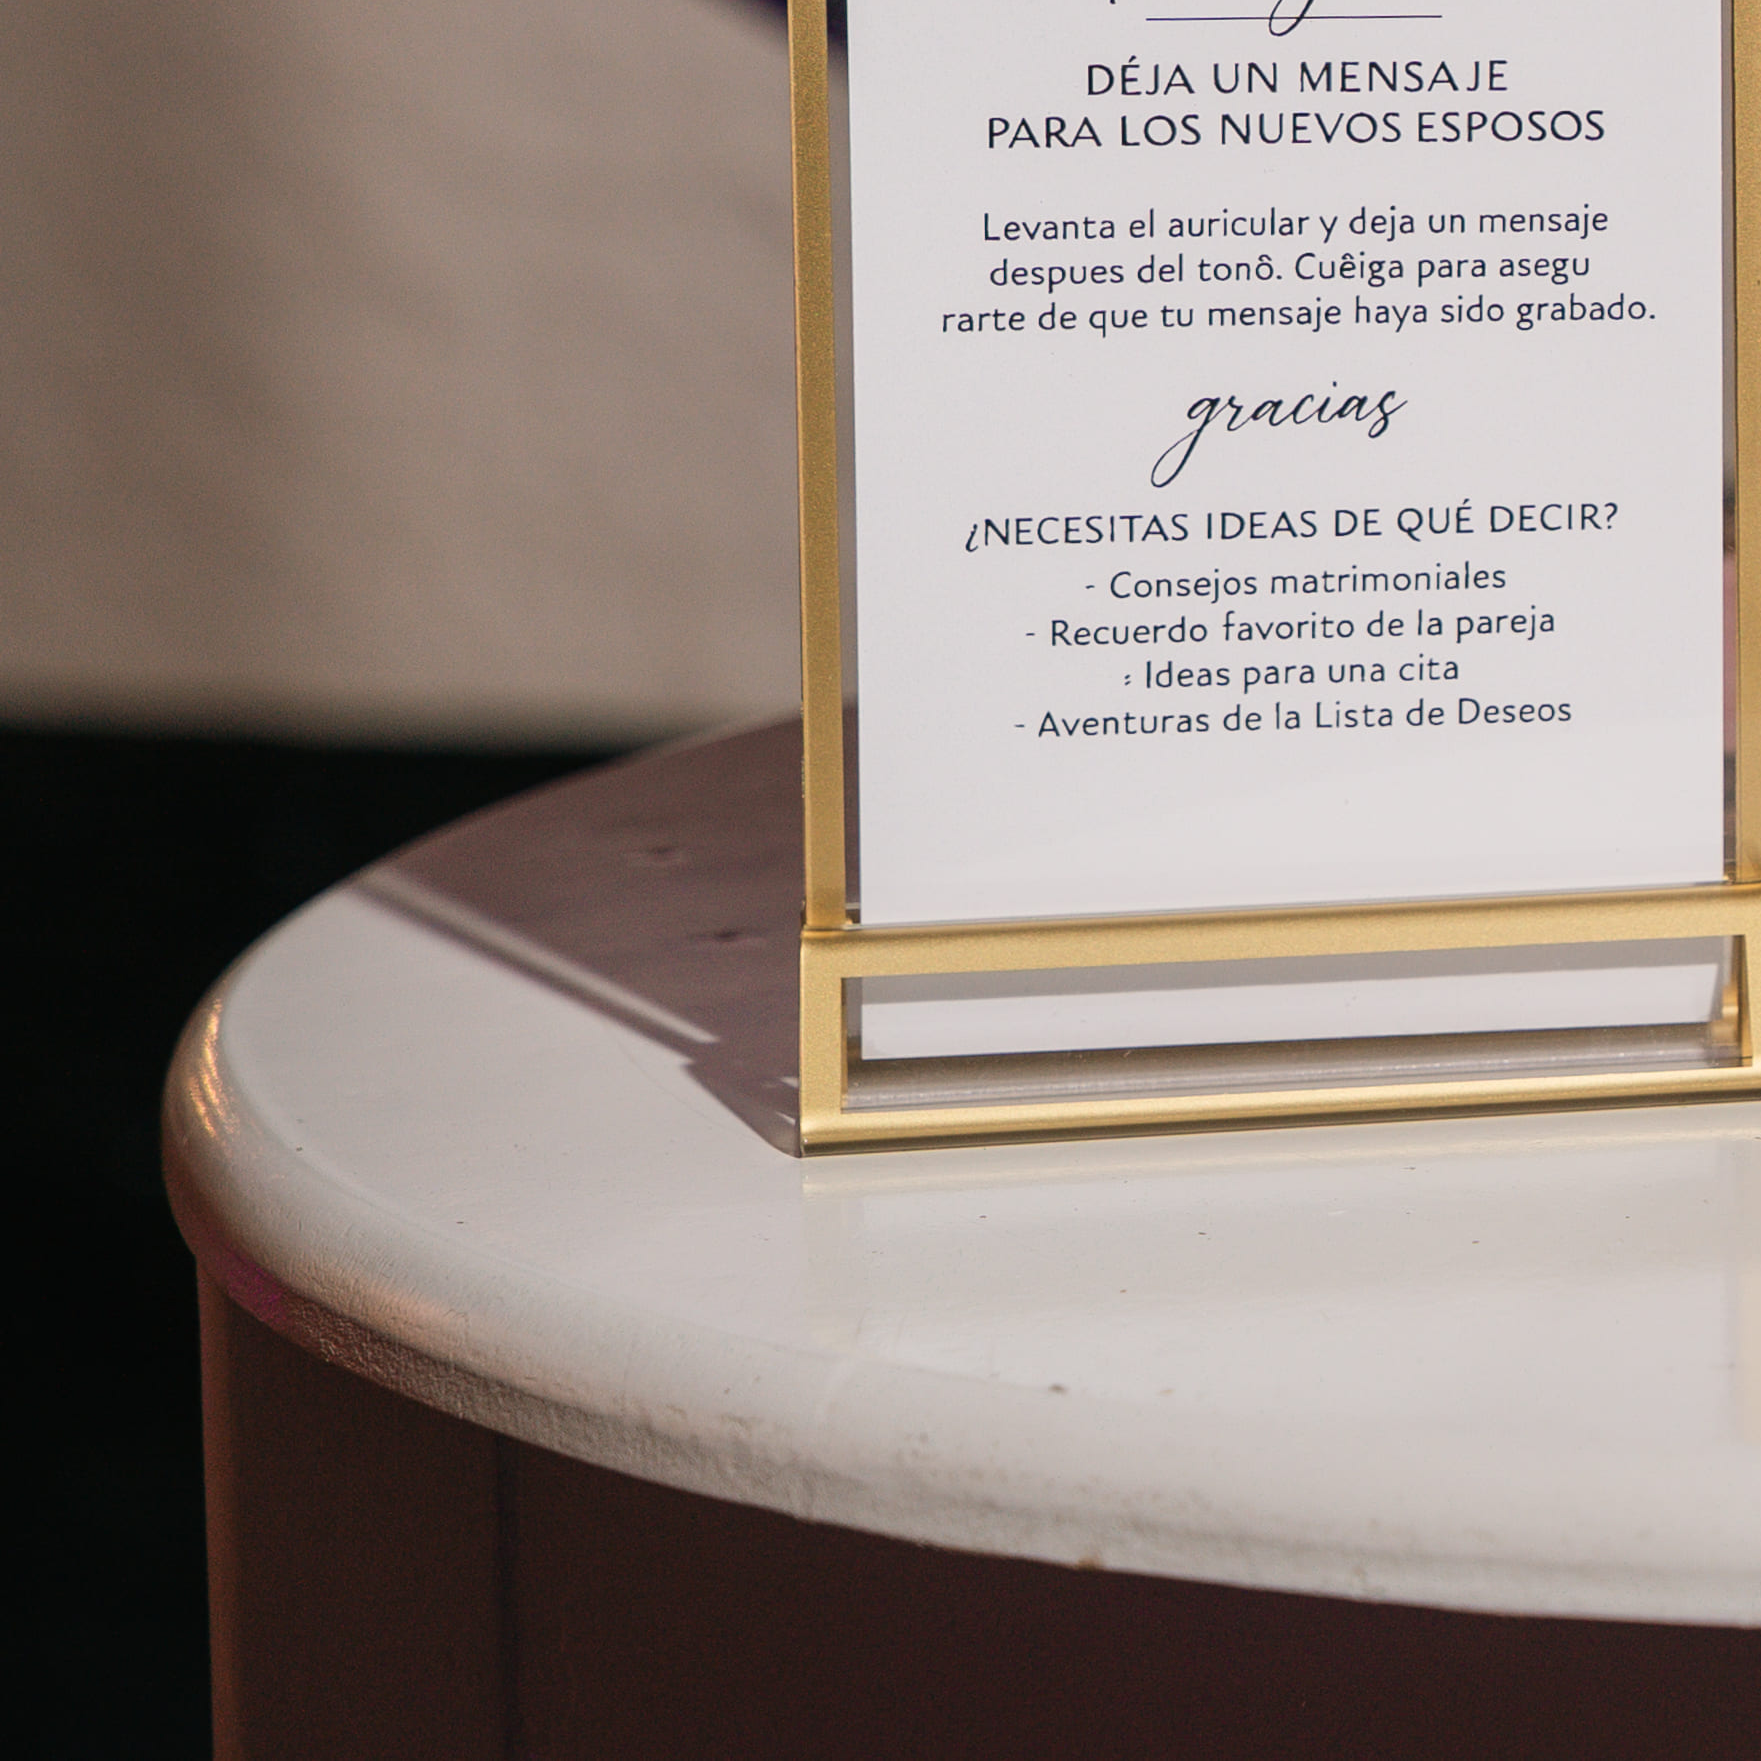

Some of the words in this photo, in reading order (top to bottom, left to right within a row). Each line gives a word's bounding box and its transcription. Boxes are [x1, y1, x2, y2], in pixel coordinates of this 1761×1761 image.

[1087, 54, 1196, 96] DÉJA
[1212, 61, 1278, 95] UN
[1299, 59, 1508, 93] MENSAJE
[988, 116, 1103, 150] PARA
[1120, 113, 1202, 147] LOS
[1221, 111, 1402, 146] NUEVOS
[1417, 109, 1605, 143] ESPOSOS
[983, 212, 1115, 242] Levanta
[1128, 207, 1155, 239] el
[1168, 206, 1311, 238] auricular
[1318, 215, 1339, 244] y
[1348, 204, 1415, 243] deja
[1428, 213, 1466, 234] un
[1479, 203, 1609, 240] mensaje
[989, 257, 1125, 295] despues
[1136, 252, 1184, 284] del
[1417, 258, 1487, 288] para
[1499, 257, 1590, 286] asegu
[942, 308, 1026, 333] rarte
[1037, 301, 1078, 331] de
[1088, 309, 1148, 339] que
[1160, 305, 1194, 328] tu
[1208, 296, 1342, 333] mensaje
[1354, 294, 1428, 334] haya
[1440, 293, 1505, 324] sido
[1515, 292, 1656, 332] grabado.
[1150, 380, 1409, 489] gracias
[964, 513, 1189, 553] ¿NECESITAS
[1206, 509, 1318, 541] IDEAS
[1334, 508, 1383, 537] DE
[1396, 497, 1475, 543] QUÉ
[1489, 501, 1619, 533] DECIR?
[1109, 568, 1258, 605] Consejos
[1270, 560, 1506, 595] matrimoniales
[1051, 615, 1208, 647] Recuerdo
[1222, 609, 1355, 642] favorito
[1366, 609, 1405, 638] de
[1417, 608, 1443, 637] la
[1455, 604, 1555, 645] pareja
[1146, 660, 1231, 689] Ideas
[1243, 664, 1315, 695] para
[1328, 662, 1386, 684] una
[1398, 652, 1459, 682] cita
[1037, 710, 1210, 738] Aventuras
[1222, 703, 1263, 732] de
[1275, 701, 1301, 730] la
[1315, 700, 1394, 729] Lista
[1405, 697, 1445, 727] de
[1458, 697, 1572, 725] Deseos
